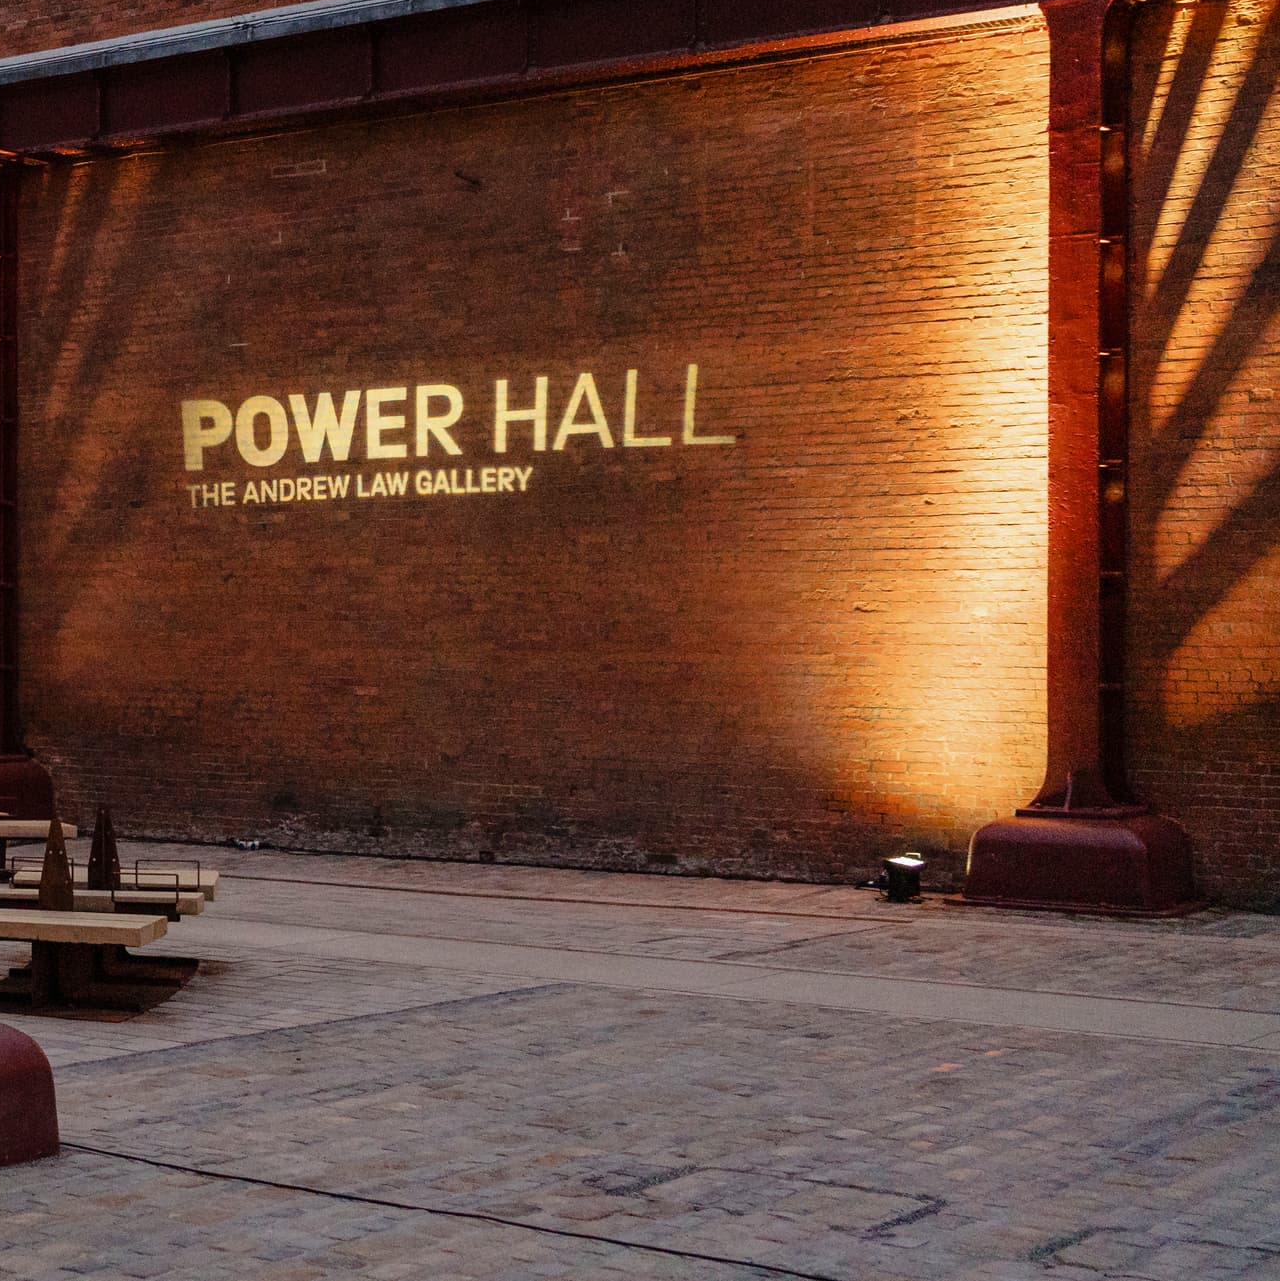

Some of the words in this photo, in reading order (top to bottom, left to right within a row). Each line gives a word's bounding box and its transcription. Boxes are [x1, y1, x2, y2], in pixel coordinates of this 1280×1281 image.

[181, 384, 465, 471] POWER
[495, 364, 735, 453] HALL
[186, 481, 236, 508] THE
[242, 474, 351, 504] ANDREW
[357, 471, 409, 498] LAW
[415, 466, 534, 496] GALLERY
